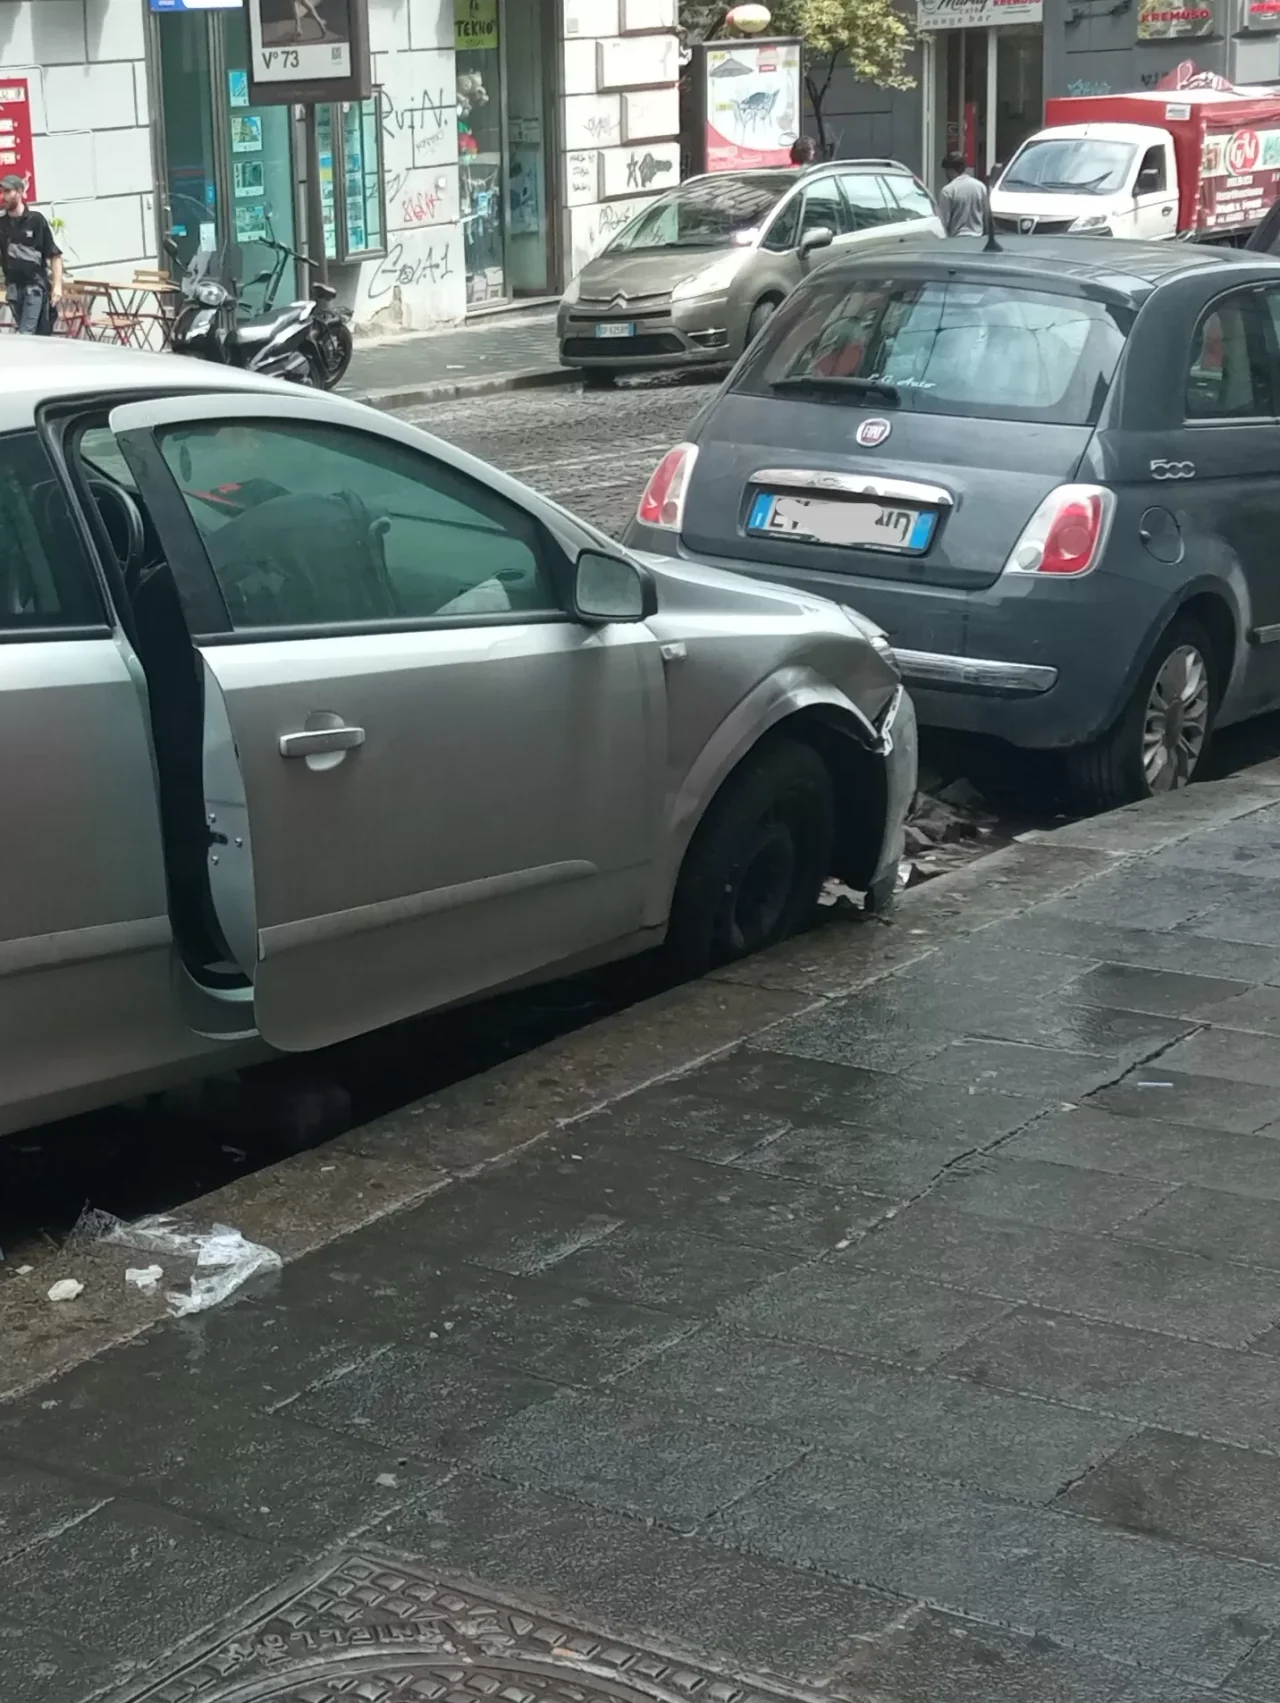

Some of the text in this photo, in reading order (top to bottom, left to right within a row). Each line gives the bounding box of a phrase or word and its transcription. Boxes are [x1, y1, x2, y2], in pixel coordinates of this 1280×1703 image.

[281, 50, 300, 68] 73
[862, 425, 885, 440] FIAT
[1150, 459, 1196, 480] 500
